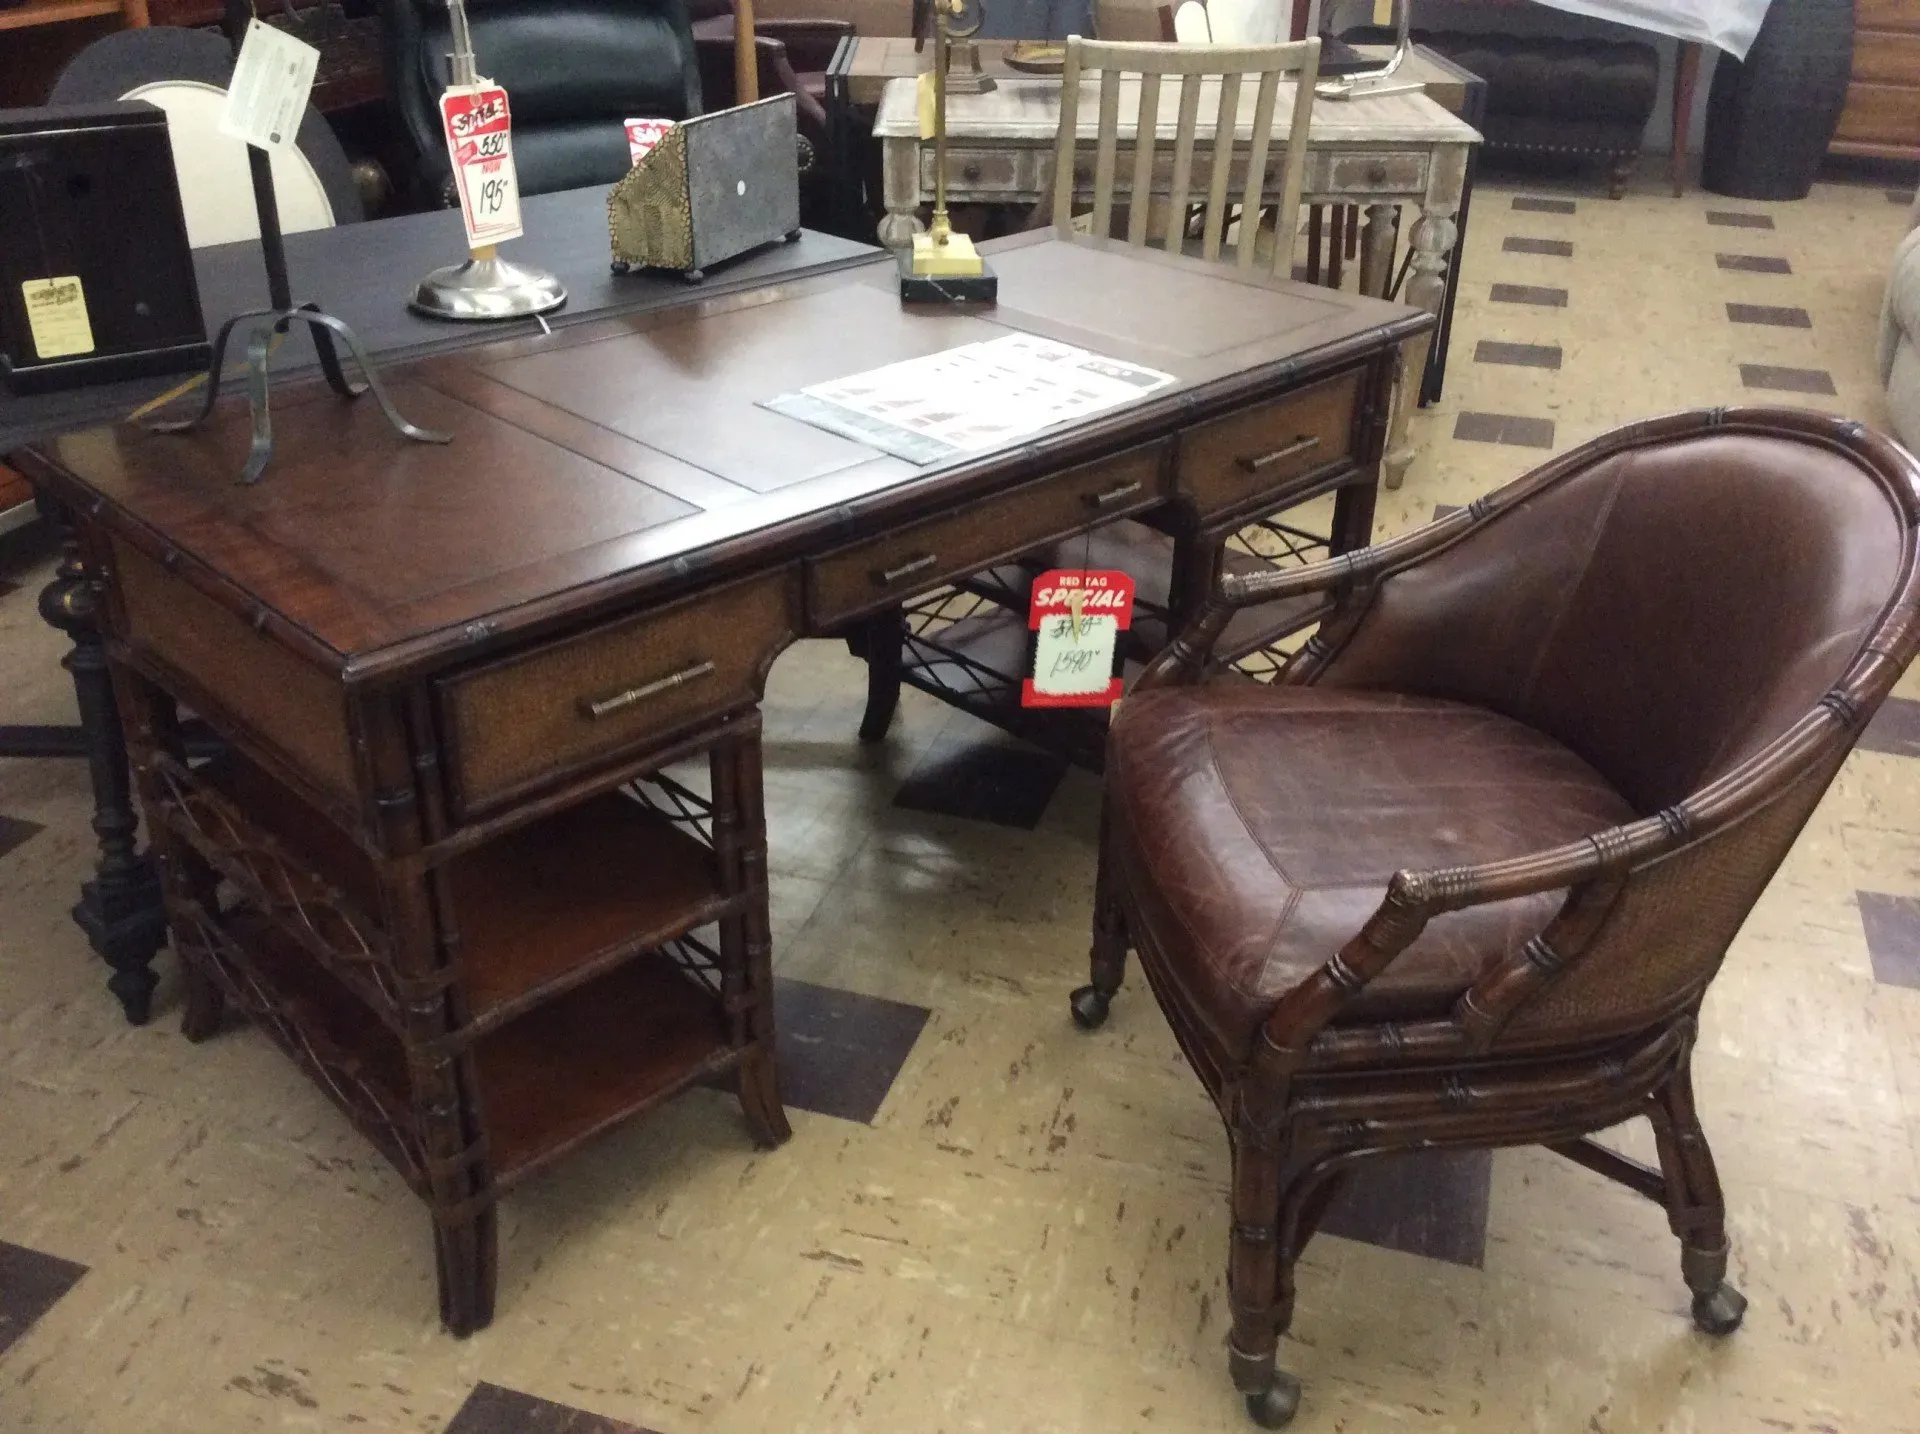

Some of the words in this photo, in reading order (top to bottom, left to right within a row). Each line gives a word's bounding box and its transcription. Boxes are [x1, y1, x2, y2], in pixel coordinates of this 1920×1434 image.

[632, 126, 667, 144] SAL
[1059, 576, 1080, 586] RED
[1085, 576, 1108, 587] TAG
[1035, 588, 1126, 607] SPECIAL
